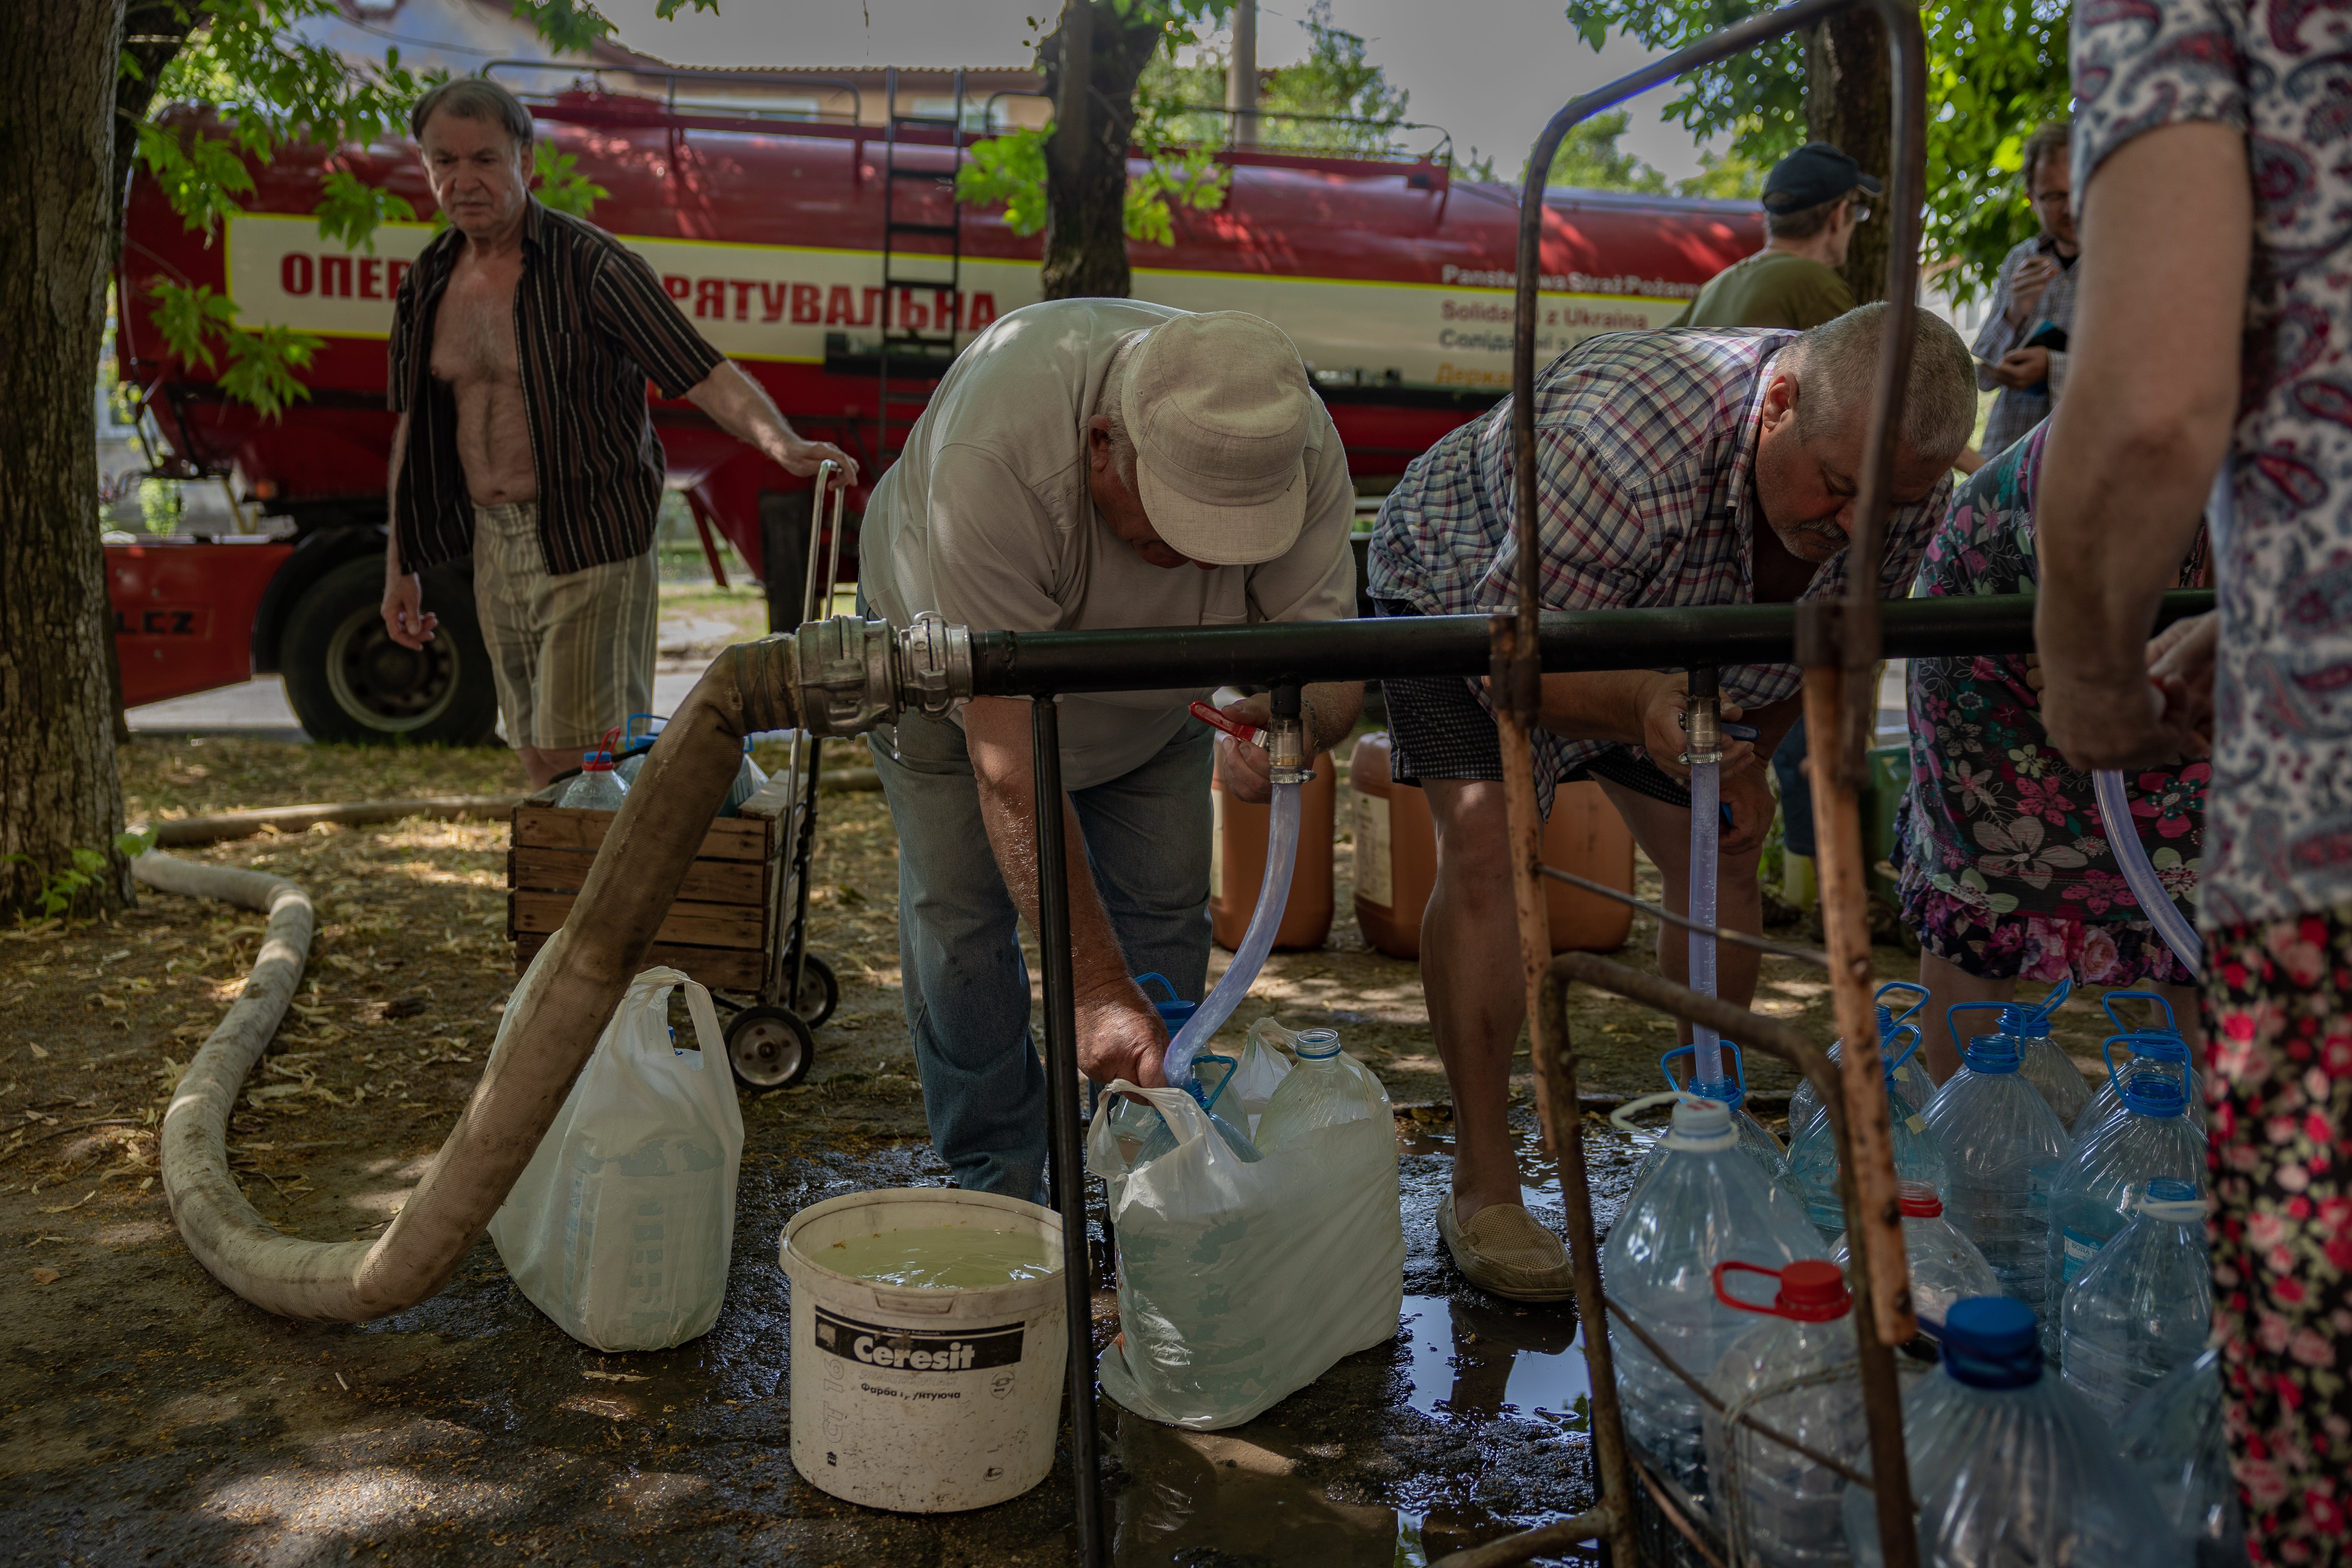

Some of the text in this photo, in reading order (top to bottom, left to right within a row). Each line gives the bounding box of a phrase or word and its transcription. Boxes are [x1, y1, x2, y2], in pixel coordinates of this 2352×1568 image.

[1546, 310, 1558, 325] z
[2071, 1242, 2090, 1254] ВОДА
[853, 1335, 975, 1370] Ceresit
[860, 1382, 898, 1397] Фарба
